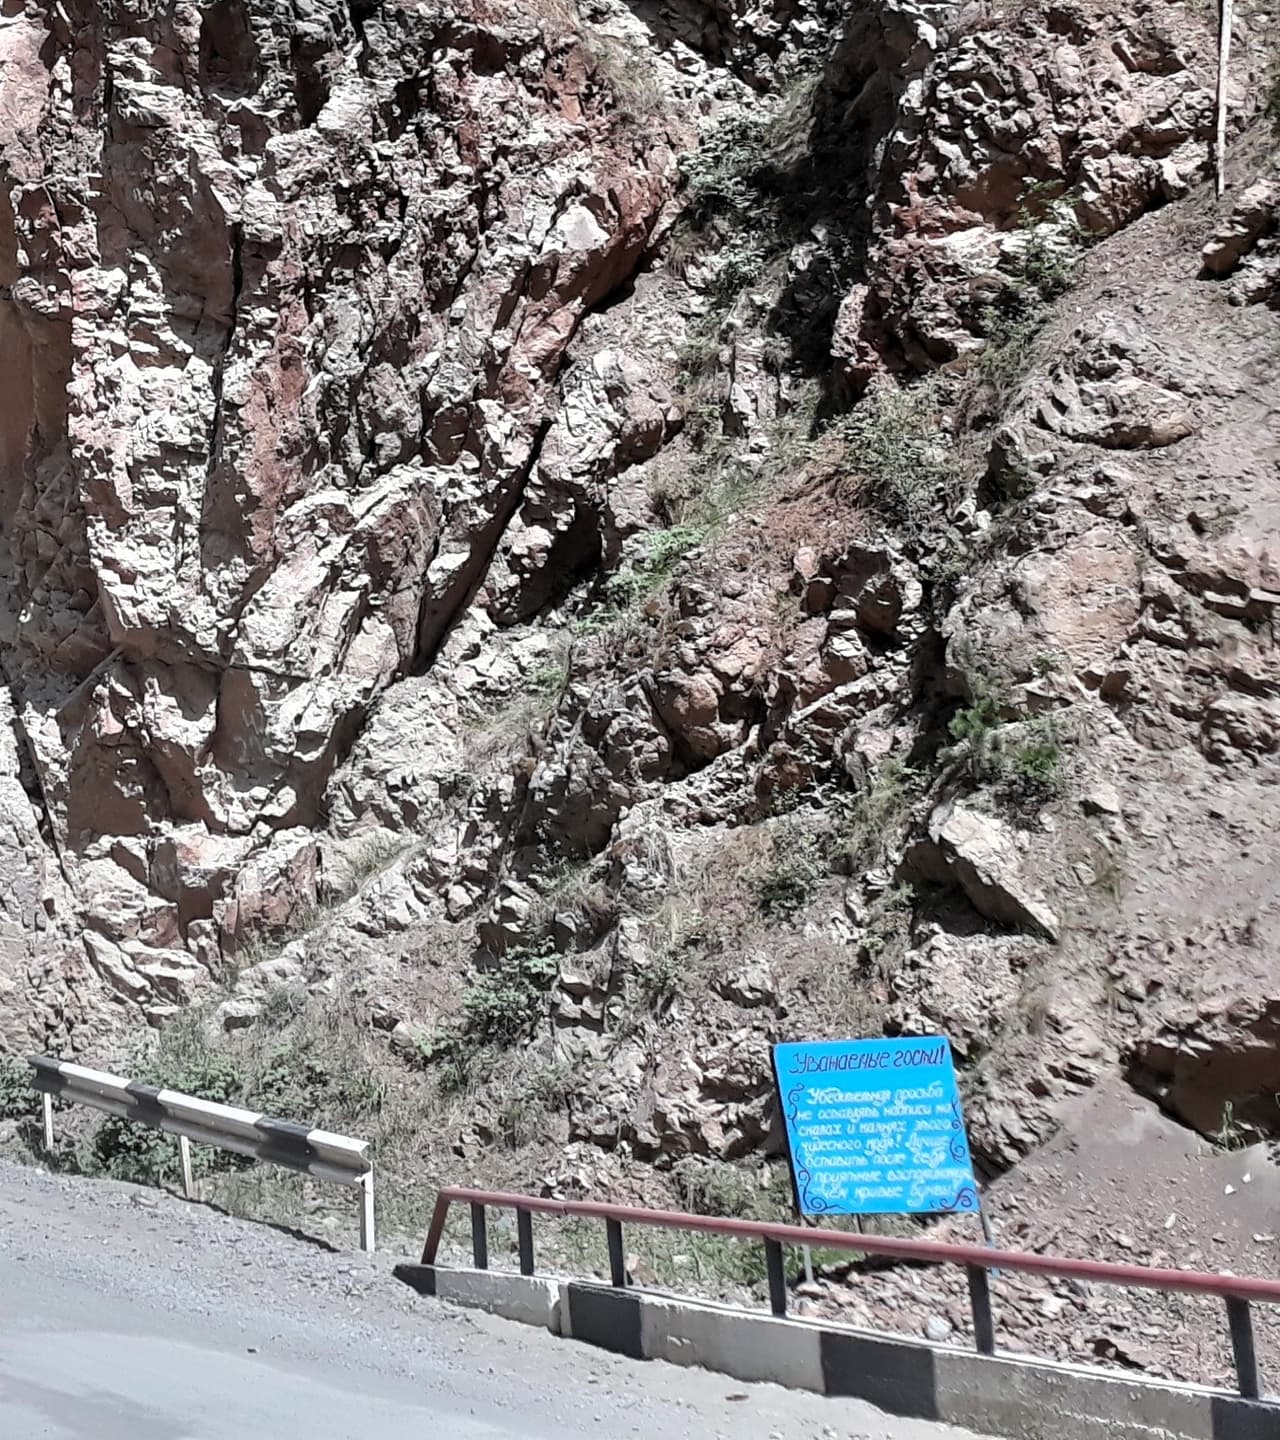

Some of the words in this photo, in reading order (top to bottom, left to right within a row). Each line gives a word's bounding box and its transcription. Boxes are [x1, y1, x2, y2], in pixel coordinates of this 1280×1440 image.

[788, 1051, 891, 1074] Уважаемые
[893, 1044, 947, 1068] гости!
[847, 1124, 855, 1134] и
